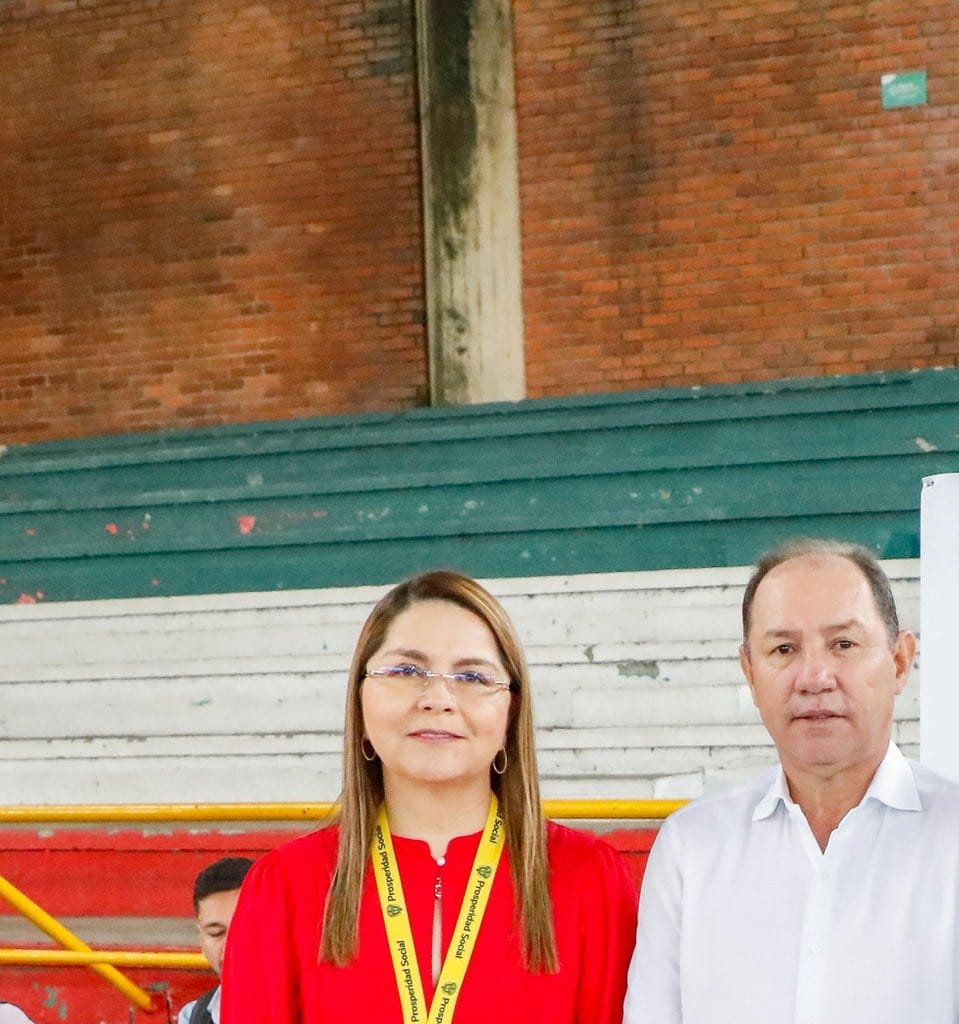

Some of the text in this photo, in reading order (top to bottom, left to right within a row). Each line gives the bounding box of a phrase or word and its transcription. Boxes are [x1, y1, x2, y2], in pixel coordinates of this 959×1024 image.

[380, 851, 396, 902] Prosperidad
[455, 880, 485, 959] Prosperidad Social
[396, 940, 419, 1022] Prosperidad Social
